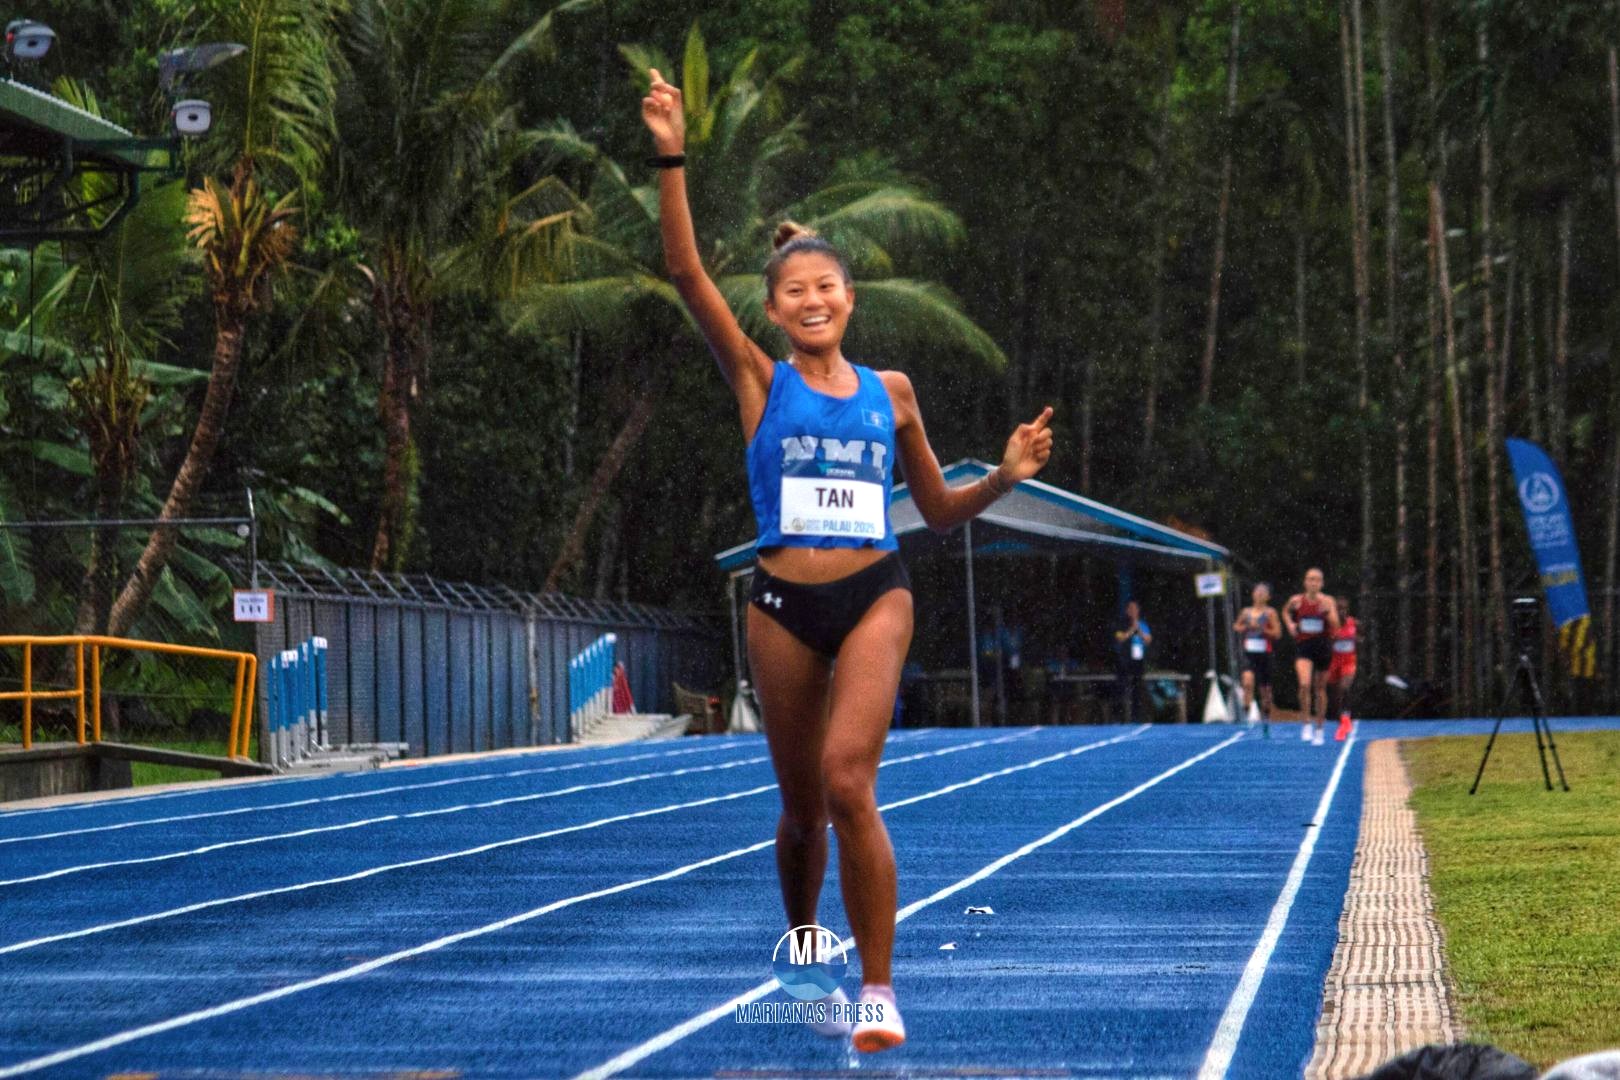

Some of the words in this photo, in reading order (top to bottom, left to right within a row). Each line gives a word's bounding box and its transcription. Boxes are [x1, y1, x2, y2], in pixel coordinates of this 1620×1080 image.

[781, 435, 886, 480] NMI
[815, 487, 854, 508] TAN
[822, 519, 852, 532] PALAU
[853, 521, 875, 534] 2025
